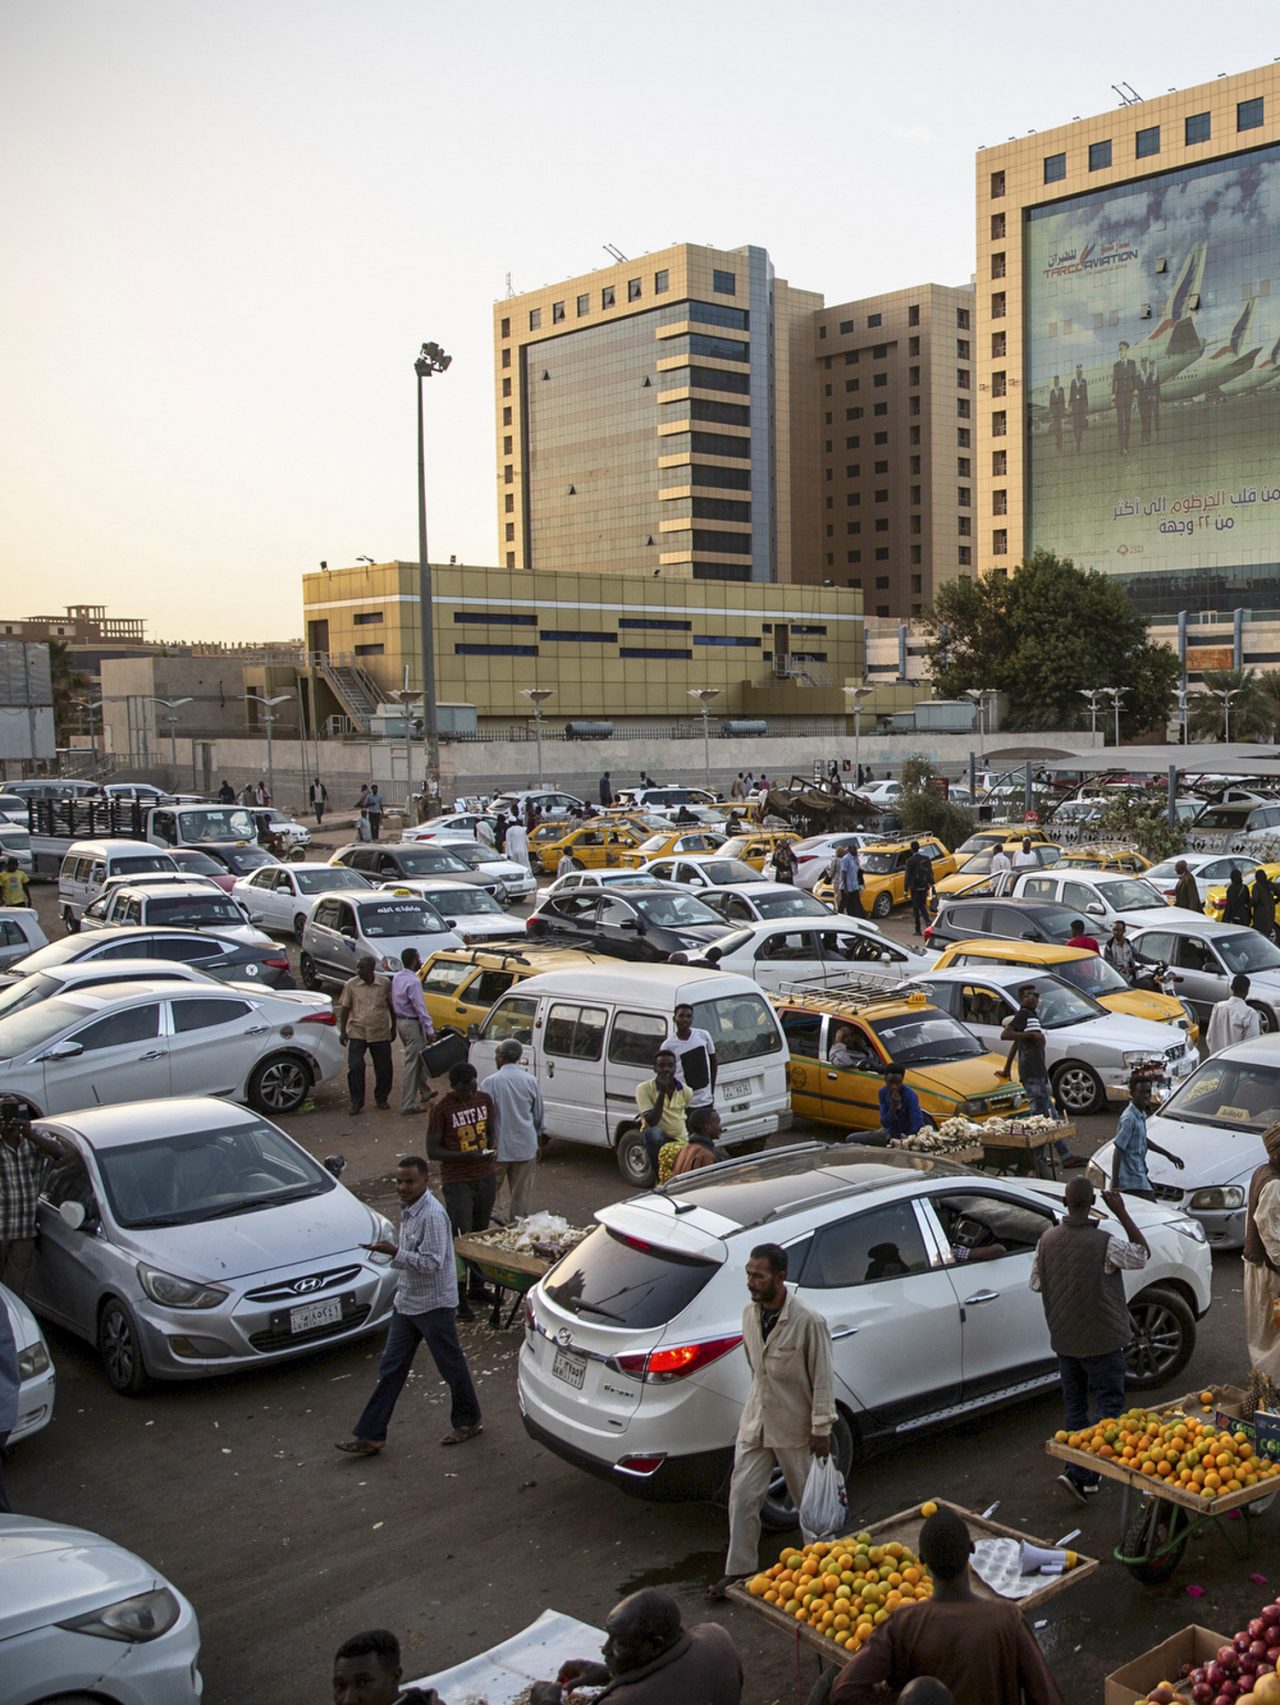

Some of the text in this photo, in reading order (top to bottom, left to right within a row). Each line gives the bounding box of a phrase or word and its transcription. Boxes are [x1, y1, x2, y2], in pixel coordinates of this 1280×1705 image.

[1084, 249, 1139, 271] AVIATION
[1170, 490, 1225, 514] الخرطوم
[1230, 487, 1257, 508] قلب
[1261, 487, 1280, 502] من
[1159, 517, 1194, 535] وجهة
[1215, 516, 1235, 531] من
